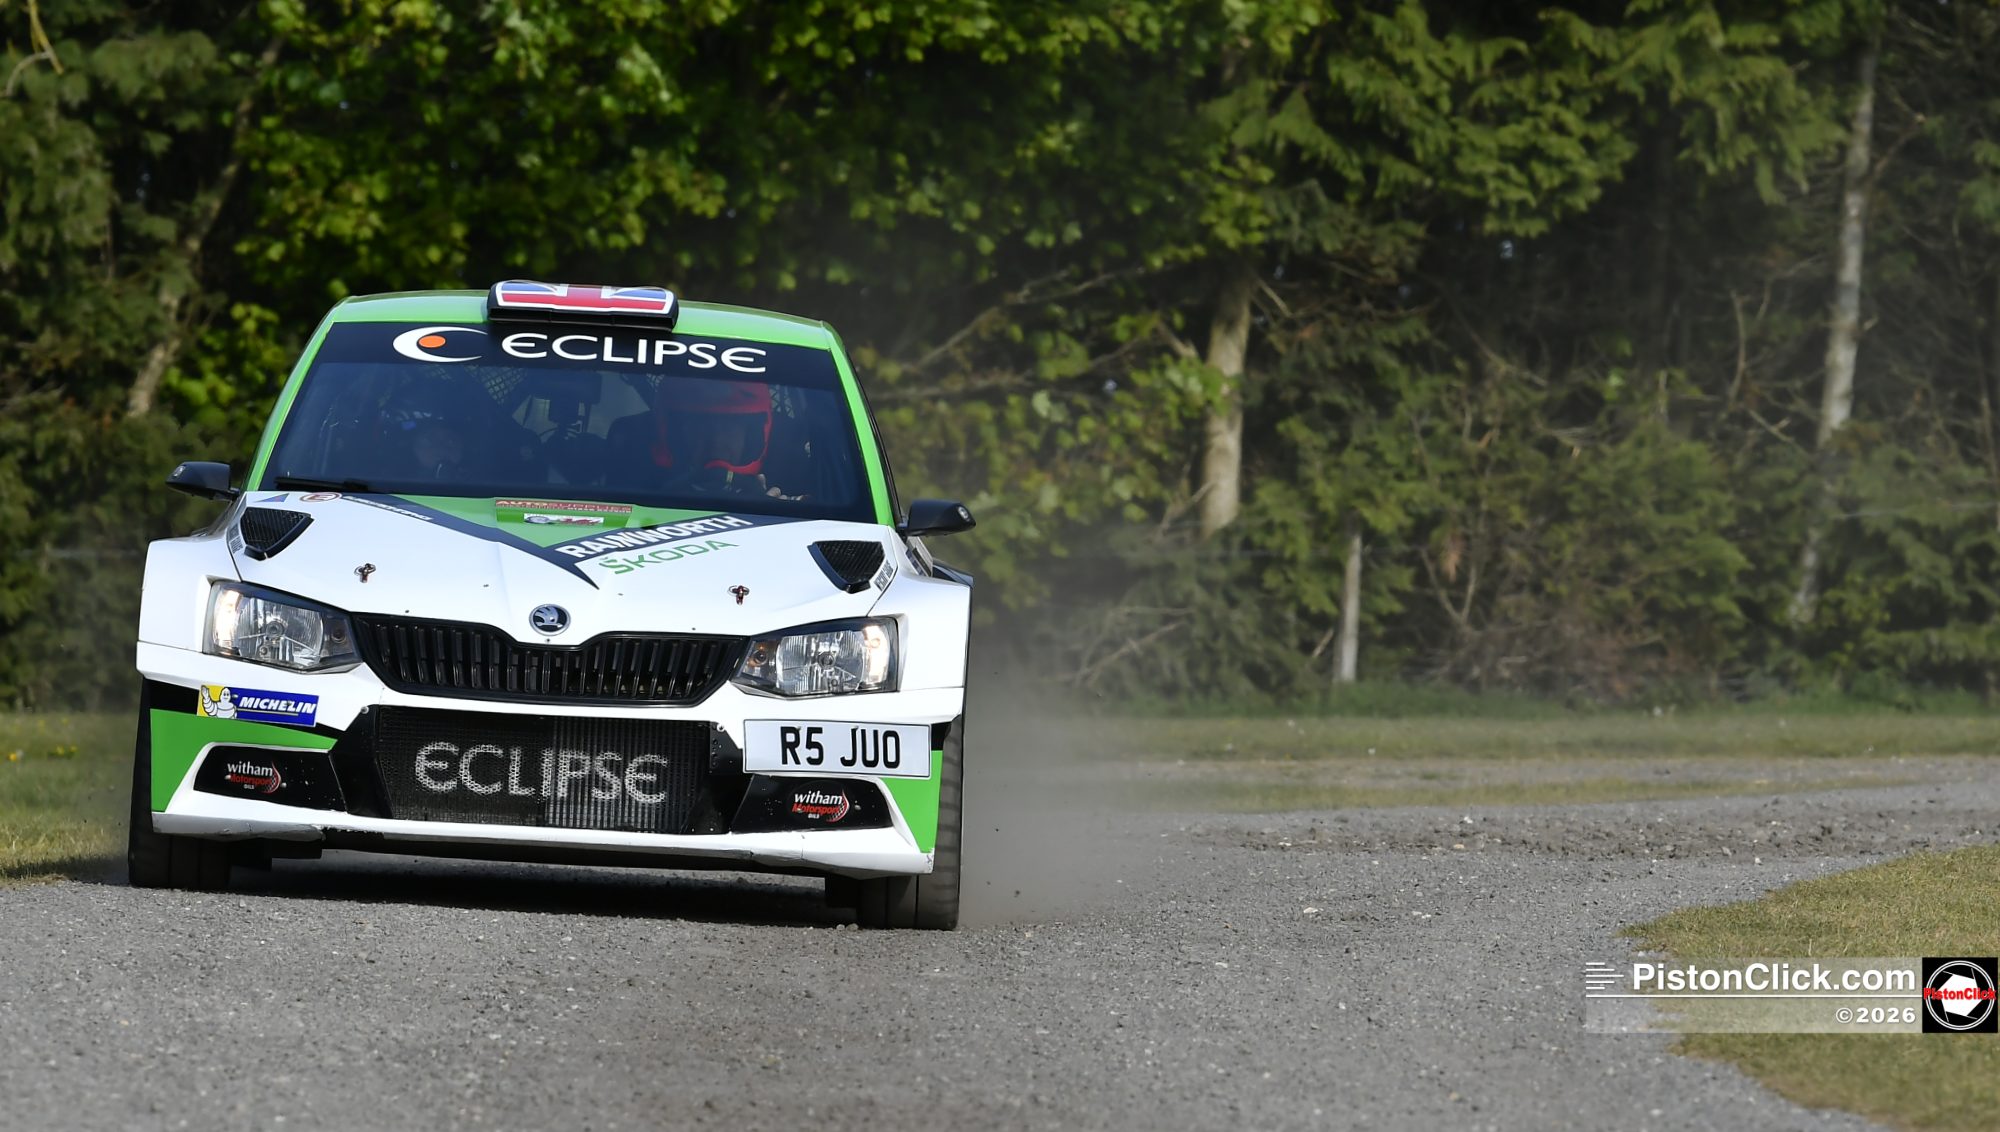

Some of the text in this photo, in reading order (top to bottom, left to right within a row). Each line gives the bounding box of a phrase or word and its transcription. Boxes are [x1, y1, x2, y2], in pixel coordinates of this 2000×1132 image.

[501, 332, 767, 373] ECLIPSE
[555, 515, 754, 558] RAINWORTH
[599, 540, 740, 575] ŠKODA
[239, 696, 317, 714] MICHELIN
[780, 726, 901, 769] R5 JUO
[227, 761, 273, 777] witham
[228, 773, 273, 787] Motorsport
[415, 741, 668, 804] ECLIPSE
[791, 803, 841, 816] Motorsport
[794, 790, 843, 805] witham
